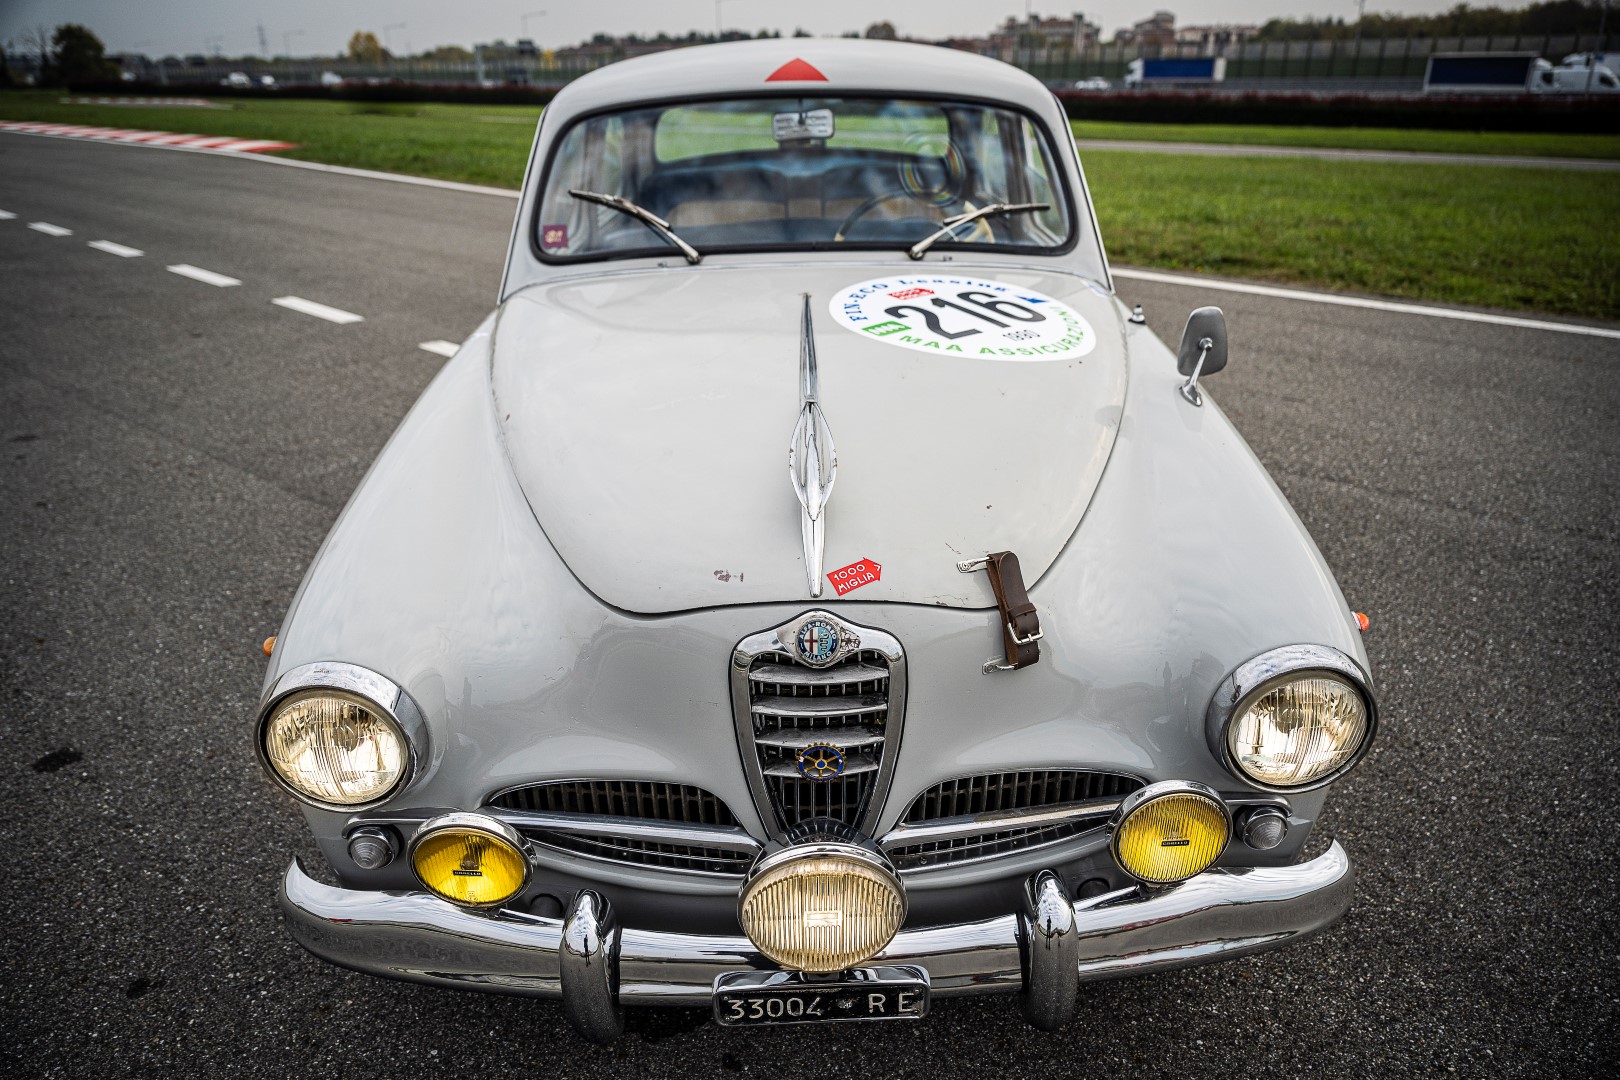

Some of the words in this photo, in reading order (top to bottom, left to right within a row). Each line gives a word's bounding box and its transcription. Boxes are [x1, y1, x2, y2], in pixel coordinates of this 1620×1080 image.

[843, 283, 889, 322] FIN-ECO
[898, 279, 1008, 292] Leasing
[884, 290, 1047, 340] 216
[899, 335, 963, 352] MAA
[979, 305, 1085, 356] ASSICURAZIONI
[833, 564, 866, 581] 1000
[837, 572, 875, 593] MIGLIA
[803, 651, 832, 660] MILANO
[728, 996, 821, 1020] 33004
